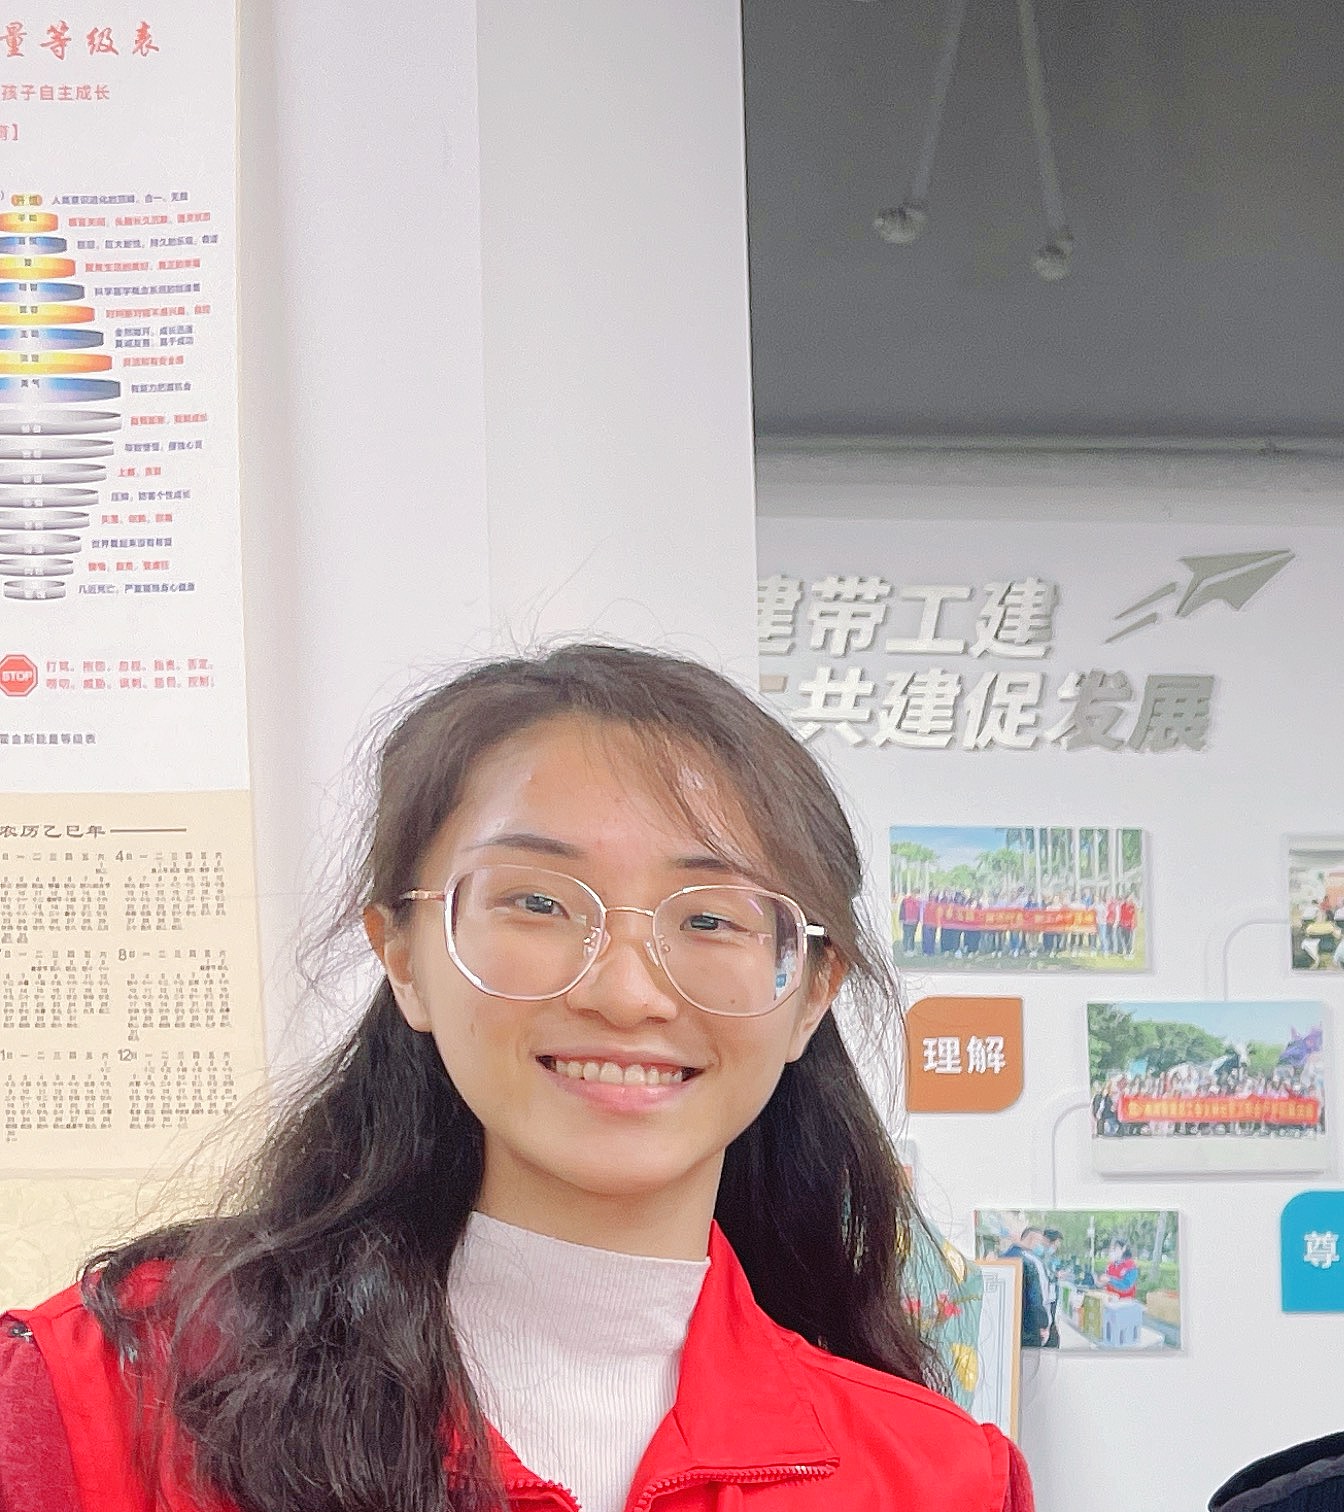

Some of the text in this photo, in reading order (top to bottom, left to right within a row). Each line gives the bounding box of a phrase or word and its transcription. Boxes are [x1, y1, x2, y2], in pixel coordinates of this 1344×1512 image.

[1, 84, 110, 101] 孩子自主成长
[2, 671, 33, 682] STOP
[792, 666, 1216, 753] 共建促发展
[0, 825, 106, 839] 农历乙巳年
[922, 1036, 1007, 1076] 理解
